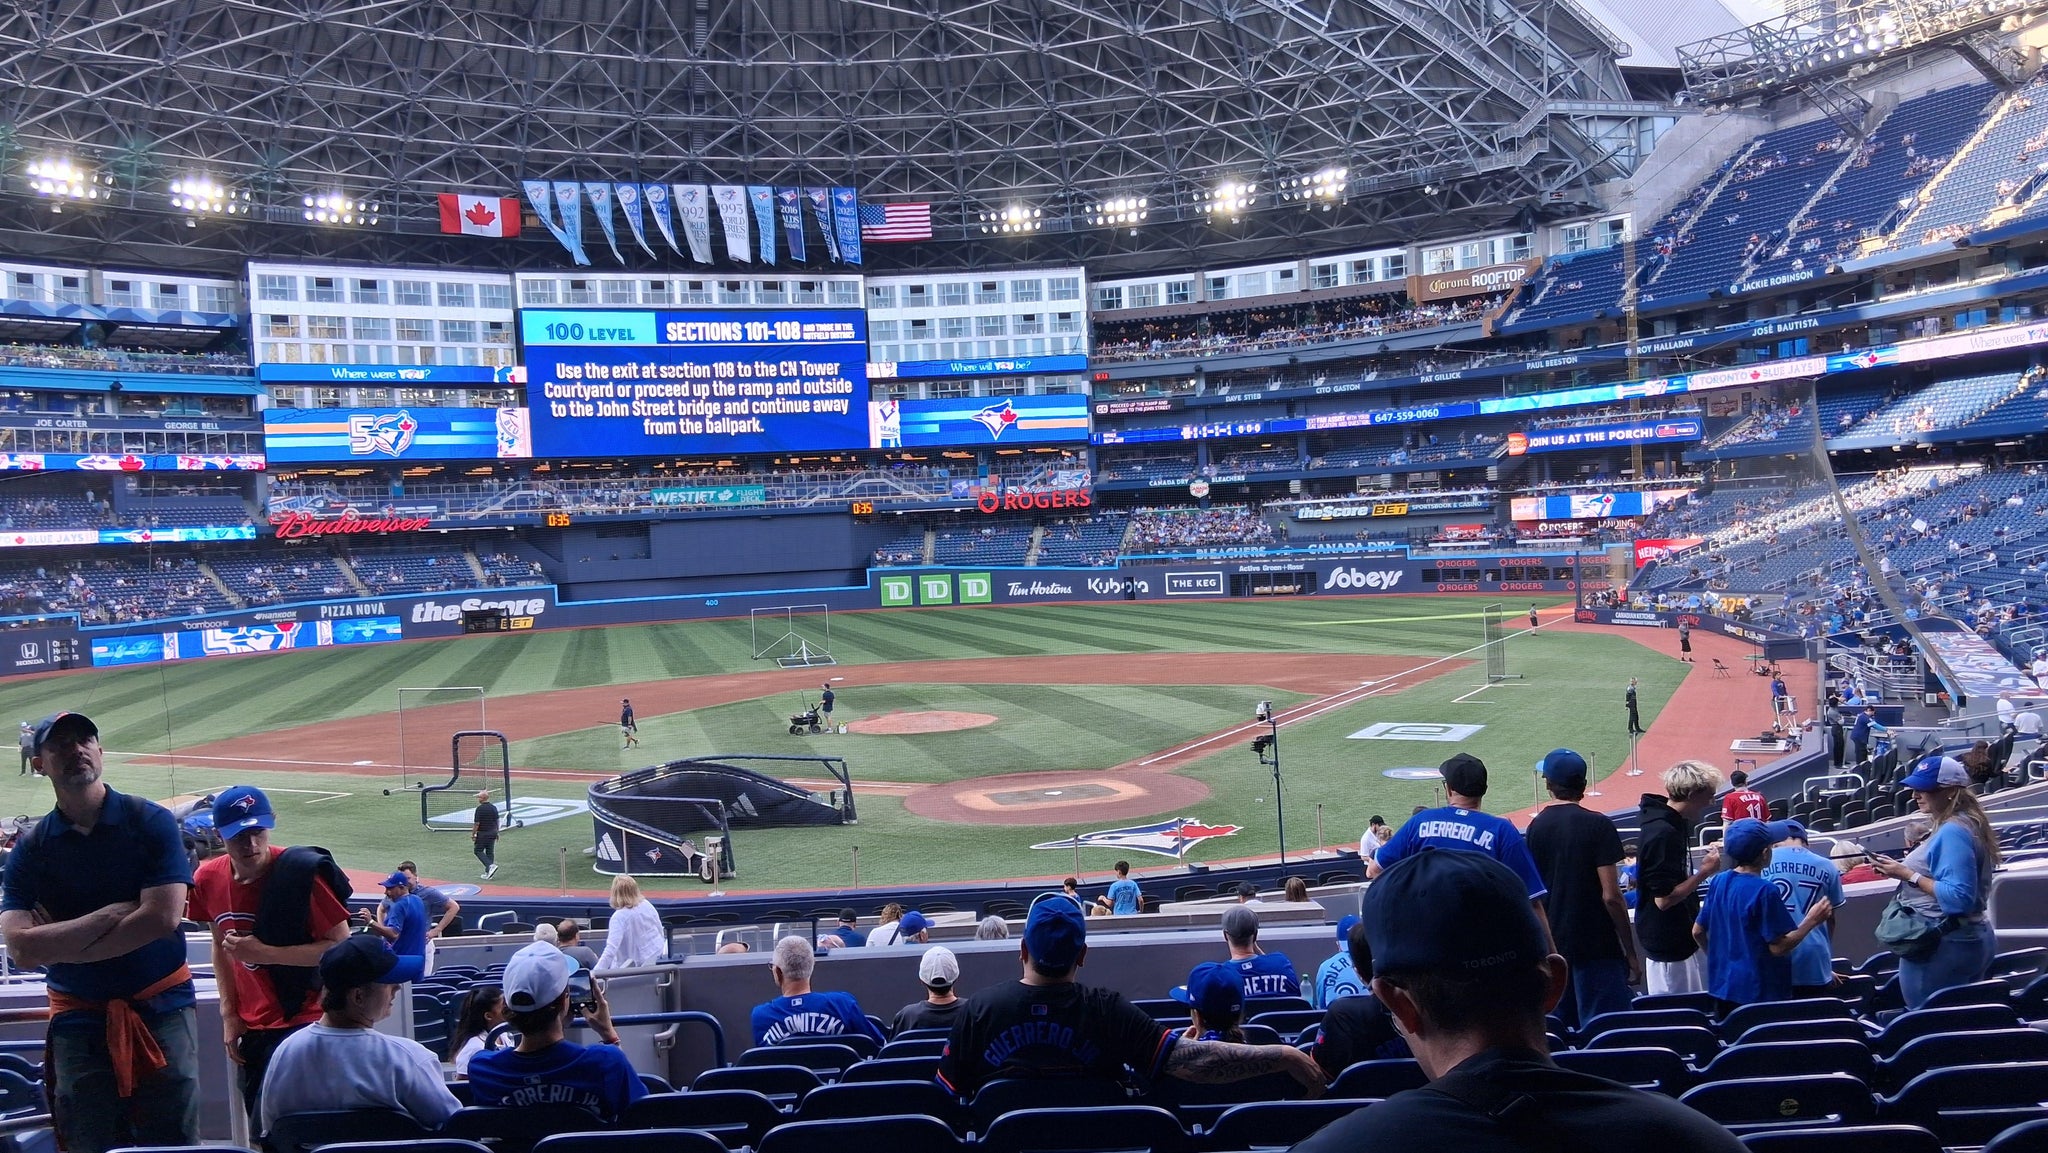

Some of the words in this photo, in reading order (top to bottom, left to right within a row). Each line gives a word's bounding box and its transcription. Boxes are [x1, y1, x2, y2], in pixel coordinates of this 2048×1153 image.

[682, 206, 704, 219] 992
[780, 206, 798, 214] 2016
[837, 207, 855, 216] 2025
[1428, 278, 1470, 294] Corona
[1471, 269, 1526, 288] ROOFTOP
[1487, 283, 1510, 291] PATIO
[1741, 279, 1768, 292] JACKIE
[1770, 270, 1813, 286] ROBINSON
[545, 323, 584, 340] 100
[589, 328, 635, 340] LEVEL
[666, 322, 742, 341] SECTIONS
[744, 321, 800, 341] 101-108
[1752, 322, 1774, 336] JOSÉ
[1777, 318, 1819, 332] BAUTISTA
[1637, 345, 1652, 355] ROY
[1654, 339, 1694, 352] HALLADAY
[556, 363, 582, 379] Use
[585, 362, 609, 378] the
[612, 362, 639, 378] exit
[642, 362, 657, 378] at
[660, 362, 710, 378] section
[713, 362, 734, 377] 108
[737, 362, 751, 377] to
[754, 362, 777, 377] the
[780, 362, 798, 377] CN
[800, 361, 840, 376] Tower
[951, 362, 983, 372] Where
[985, 362, 993, 371] will
[1016, 361, 1032, 370] be?
[1526, 361, 1544, 370] PAUL
[1546, 356, 1578, 368] BEESTON
[332, 368, 367, 379] Where
[370, 371, 396, 379] were
[1420, 375, 1433, 383] PAT
[1435, 372, 1461, 381] GILLICK
[544, 382, 613, 401] Courtyard
[617, 385, 631, 397] or
[635, 381, 689, 399] proceed
[692, 383, 710, 399] up
[712, 380, 735, 396] the
[739, 382, 773, 398] ramp
[776, 379, 800, 394] and
[804, 378, 852, 394] outside
[1316, 386, 1331, 394] CITO
[1334, 384, 1360, 393] GASTON
[1226, 394, 1241, 402] DAVE
[1244, 393, 1261, 401] STIEB
[551, 402, 562, 417] to
[570, 401, 593, 417] the
[597, 401, 629, 417] John
[632, 400, 675, 416] Street
[678, 399, 721, 418] bridge
[724, 399, 748, 414] and
[752, 398, 810, 414] continue
[813, 399, 848, 415] away
[1375, 408, 1439, 423] 647-559-0060
[35, 419, 52, 427] JOE
[56, 420, 87, 428] CARTER
[164, 422, 198, 430] GEORGE
[202, 422, 219, 430] BELL
[644, 419, 676, 435] from
[680, 419, 702, 434] the
[706, 417, 764, 435] ballpark.
[1529, 437, 1548, 447] JOIN
[1551, 436, 1564, 445] US
[1567, 434, 1581, 444] AT
[1582, 432, 1604, 442] THE
[1609, 429, 1653, 440] PORCH!
[1212, 475, 1245, 483] BLEACHERS
[653, 491, 717, 503] WESTJET
[1004, 489, 1091, 510] ROGERS
[853, 502, 873, 514] 0:35
[1298, 505, 1368, 519] theScore
[1374, 504, 1406, 515] BET
[270, 512, 430, 538] Budweiser
[548, 514, 570, 527] 0:35
[1549, 523, 1583, 531] ROGERS
[1598, 520, 1633, 530] LANDING
[1196, 546, 1266, 560] BLEACHERS
[1309, 543, 1363, 554] CANADA
[1088, 577, 1149, 595] Kubota
[1196, 579, 1216, 587] KEG
[1324, 567, 1403, 590] Sobeys
[884, 582, 909, 601] TD
[923, 580, 949, 599] TD
[962, 579, 988, 597] TD
[1008, 582, 1032, 596] Tim
[1033, 581, 1072, 596] Hortons
[321, 604, 353, 618] PIZZA
[357, 602, 385, 616] NOVA
[1577, 611, 1596, 621] HEINZ
[502, 618, 532, 628] BET
[1676, 616, 1700, 626] HEINZ
[16, 658, 45, 666] HONDA
[1746, 803, 1761, 819] 11
[1419, 821, 1475, 842] GUERRERO
[1474, 830, 1494, 850] JR.
[1762, 862, 1816, 877] GUERRERO
[1770, 878, 1824, 914] 27
[1462, 951, 1517, 970] TORONTO
[1244, 975, 1288, 996] HETTE
[984, 1021, 1074, 1067] GUERRERO
[512, 1084, 575, 1106] RRERO
